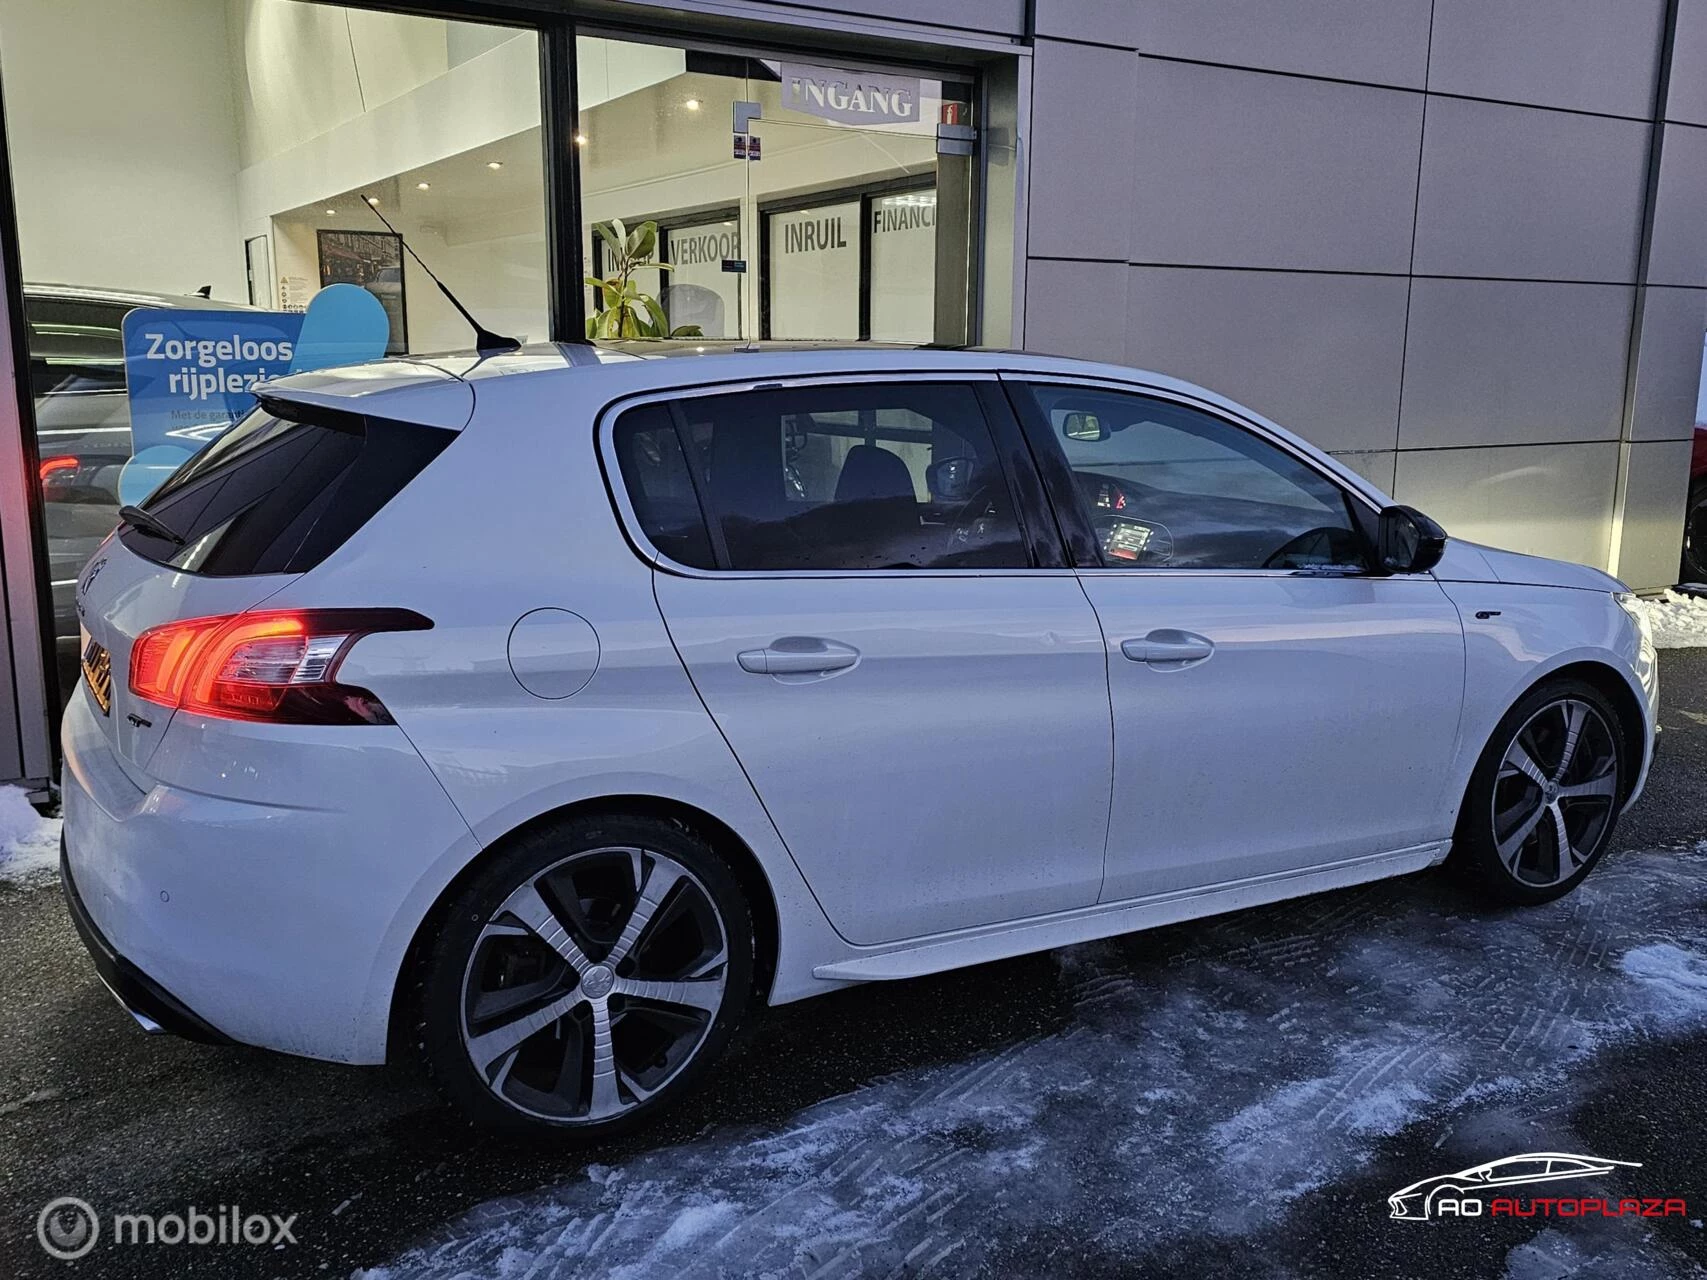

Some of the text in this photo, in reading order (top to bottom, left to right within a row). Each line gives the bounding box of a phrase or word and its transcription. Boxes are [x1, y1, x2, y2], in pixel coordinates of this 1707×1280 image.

[785, 217, 846, 253] INRUIL
[873, 205, 936, 234] FINANCI
[145, 333, 293, 368] Zorgeloos
[169, 367, 281, 400] rijplezi
